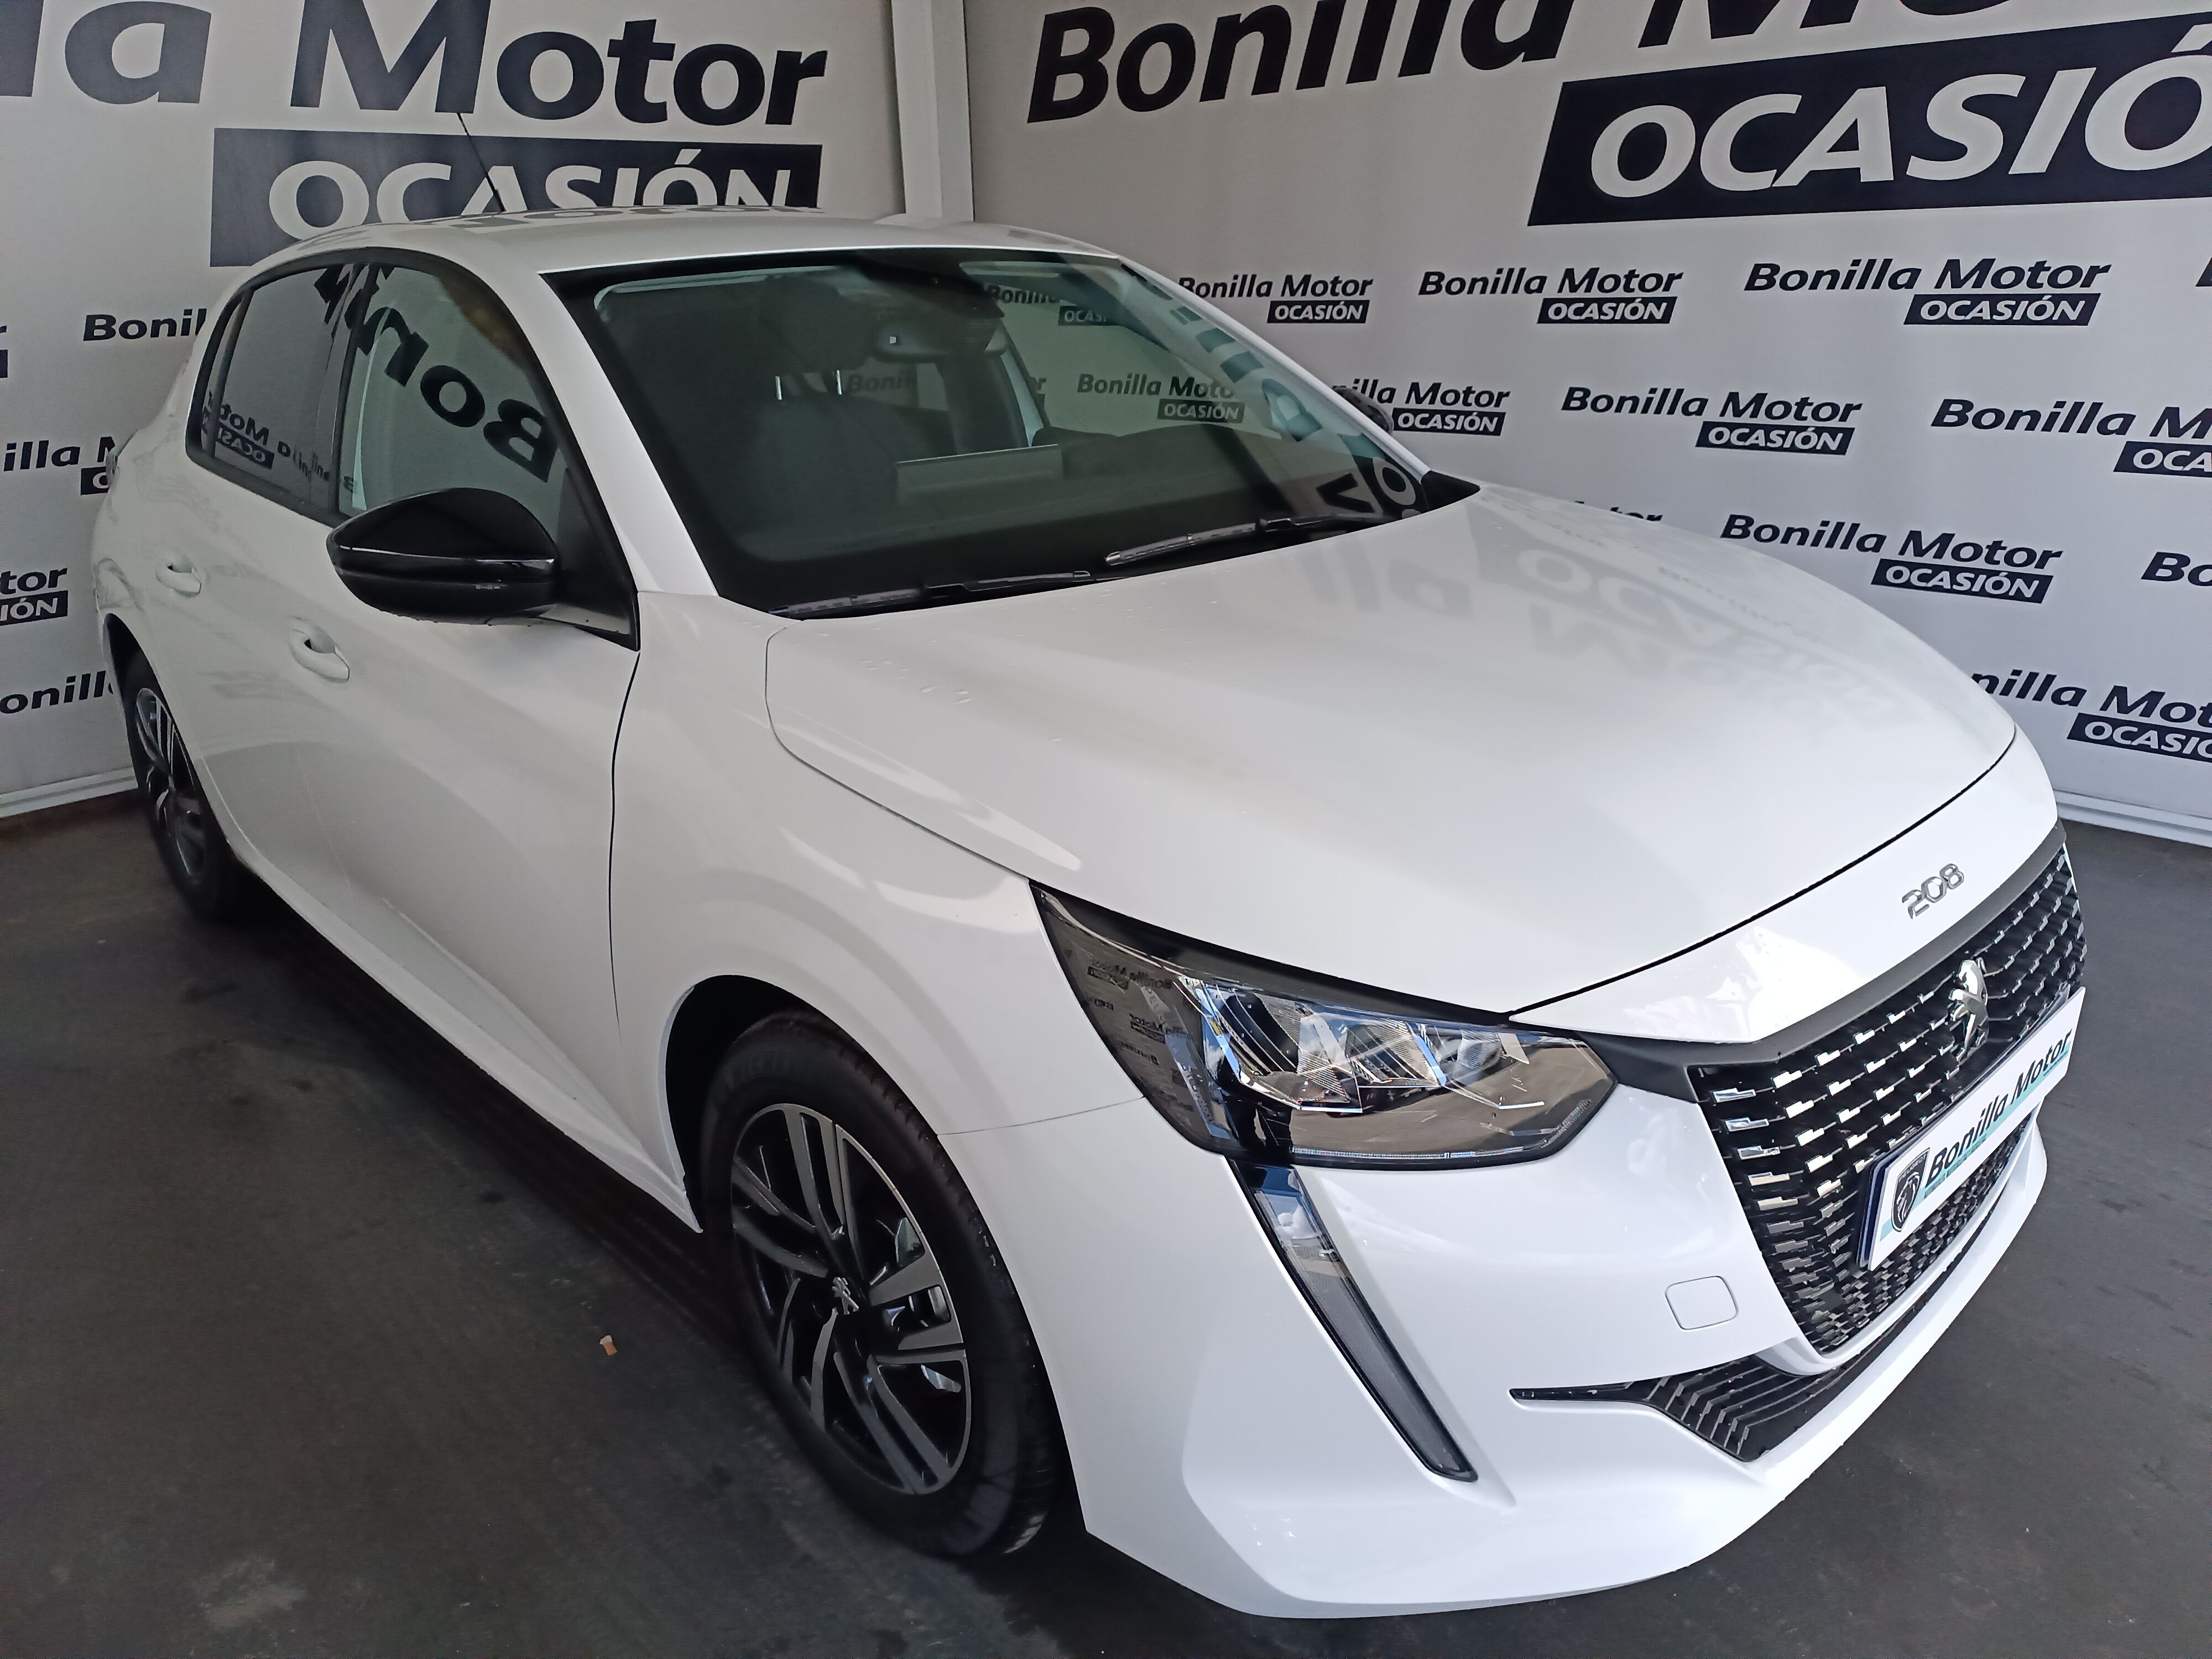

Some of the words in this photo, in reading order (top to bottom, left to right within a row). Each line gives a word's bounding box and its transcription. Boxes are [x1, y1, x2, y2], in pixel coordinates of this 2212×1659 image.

[290, 0, 828, 126] Motor
[269, 149, 791, 241] OCASIÓN
[1281, 273, 1374, 297] Motor
[1418, 268, 1548, 296] Bonilla
[1557, 267, 1684, 294] Motor
[1744, 258, 1922, 291] Bonilla
[1933, 258, 2112, 289] Motor
[1275, 301, 1363, 320] OCASIÓN
[1548, 299, 1668, 321] OCASIÓN
[1920, 295, 2085, 321] OCASIÓN
[1077, 372, 1161, 395] Bonilla
[1333, 378, 1397, 404] illa
[1405, 382, 1511, 408] Motor
[1164, 402, 1239, 420] OCASIÓN
[1561, 387, 1709, 416] Bonilla
[1719, 391, 1863, 423] Motor
[1931, 399, 2136, 436] Bonilla
[1397, 412, 1499, 432] OCASIÓN
[1708, 426, 1844, 451] OCASIÓN
[1720, 514, 1887, 553] Bonilla
[1898, 530, 2064, 570] Motor
[1886, 565, 2040, 598] OCASIÓN
[0, 670, 113, 714] onill
[1901, 863, 1964, 920] 208
[1925, 1093, 2008, 1188] Bonilla
[2010, 1027, 2073, 1105] Motor
